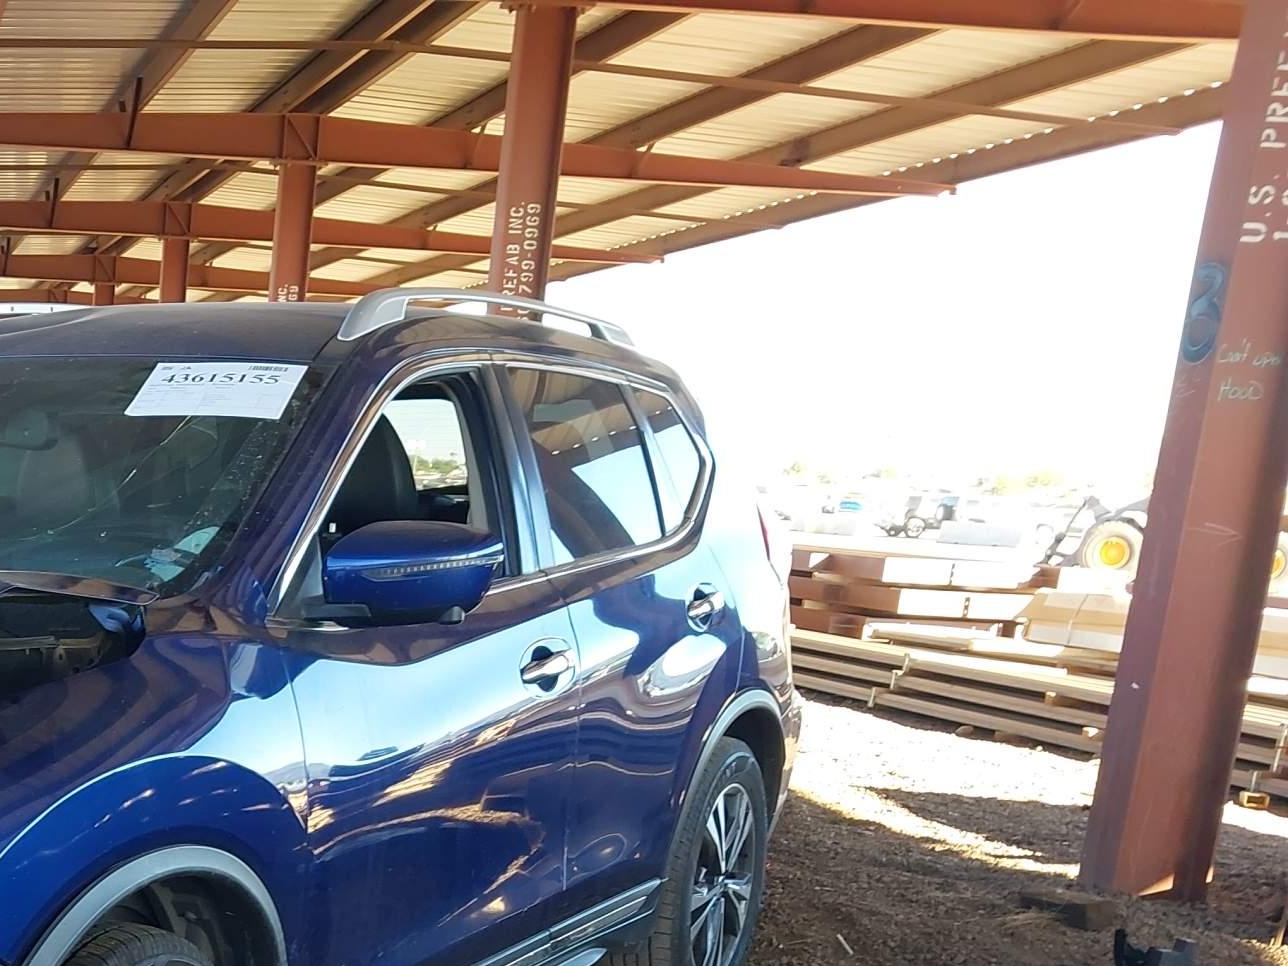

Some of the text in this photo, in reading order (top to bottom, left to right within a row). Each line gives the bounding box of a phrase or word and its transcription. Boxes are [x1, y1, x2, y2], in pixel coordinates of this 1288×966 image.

[1239, 173, 1280, 243] U.S.
[500, 201, 526, 312] REFAB INC.
[160, 372, 281, 385] 43615155
